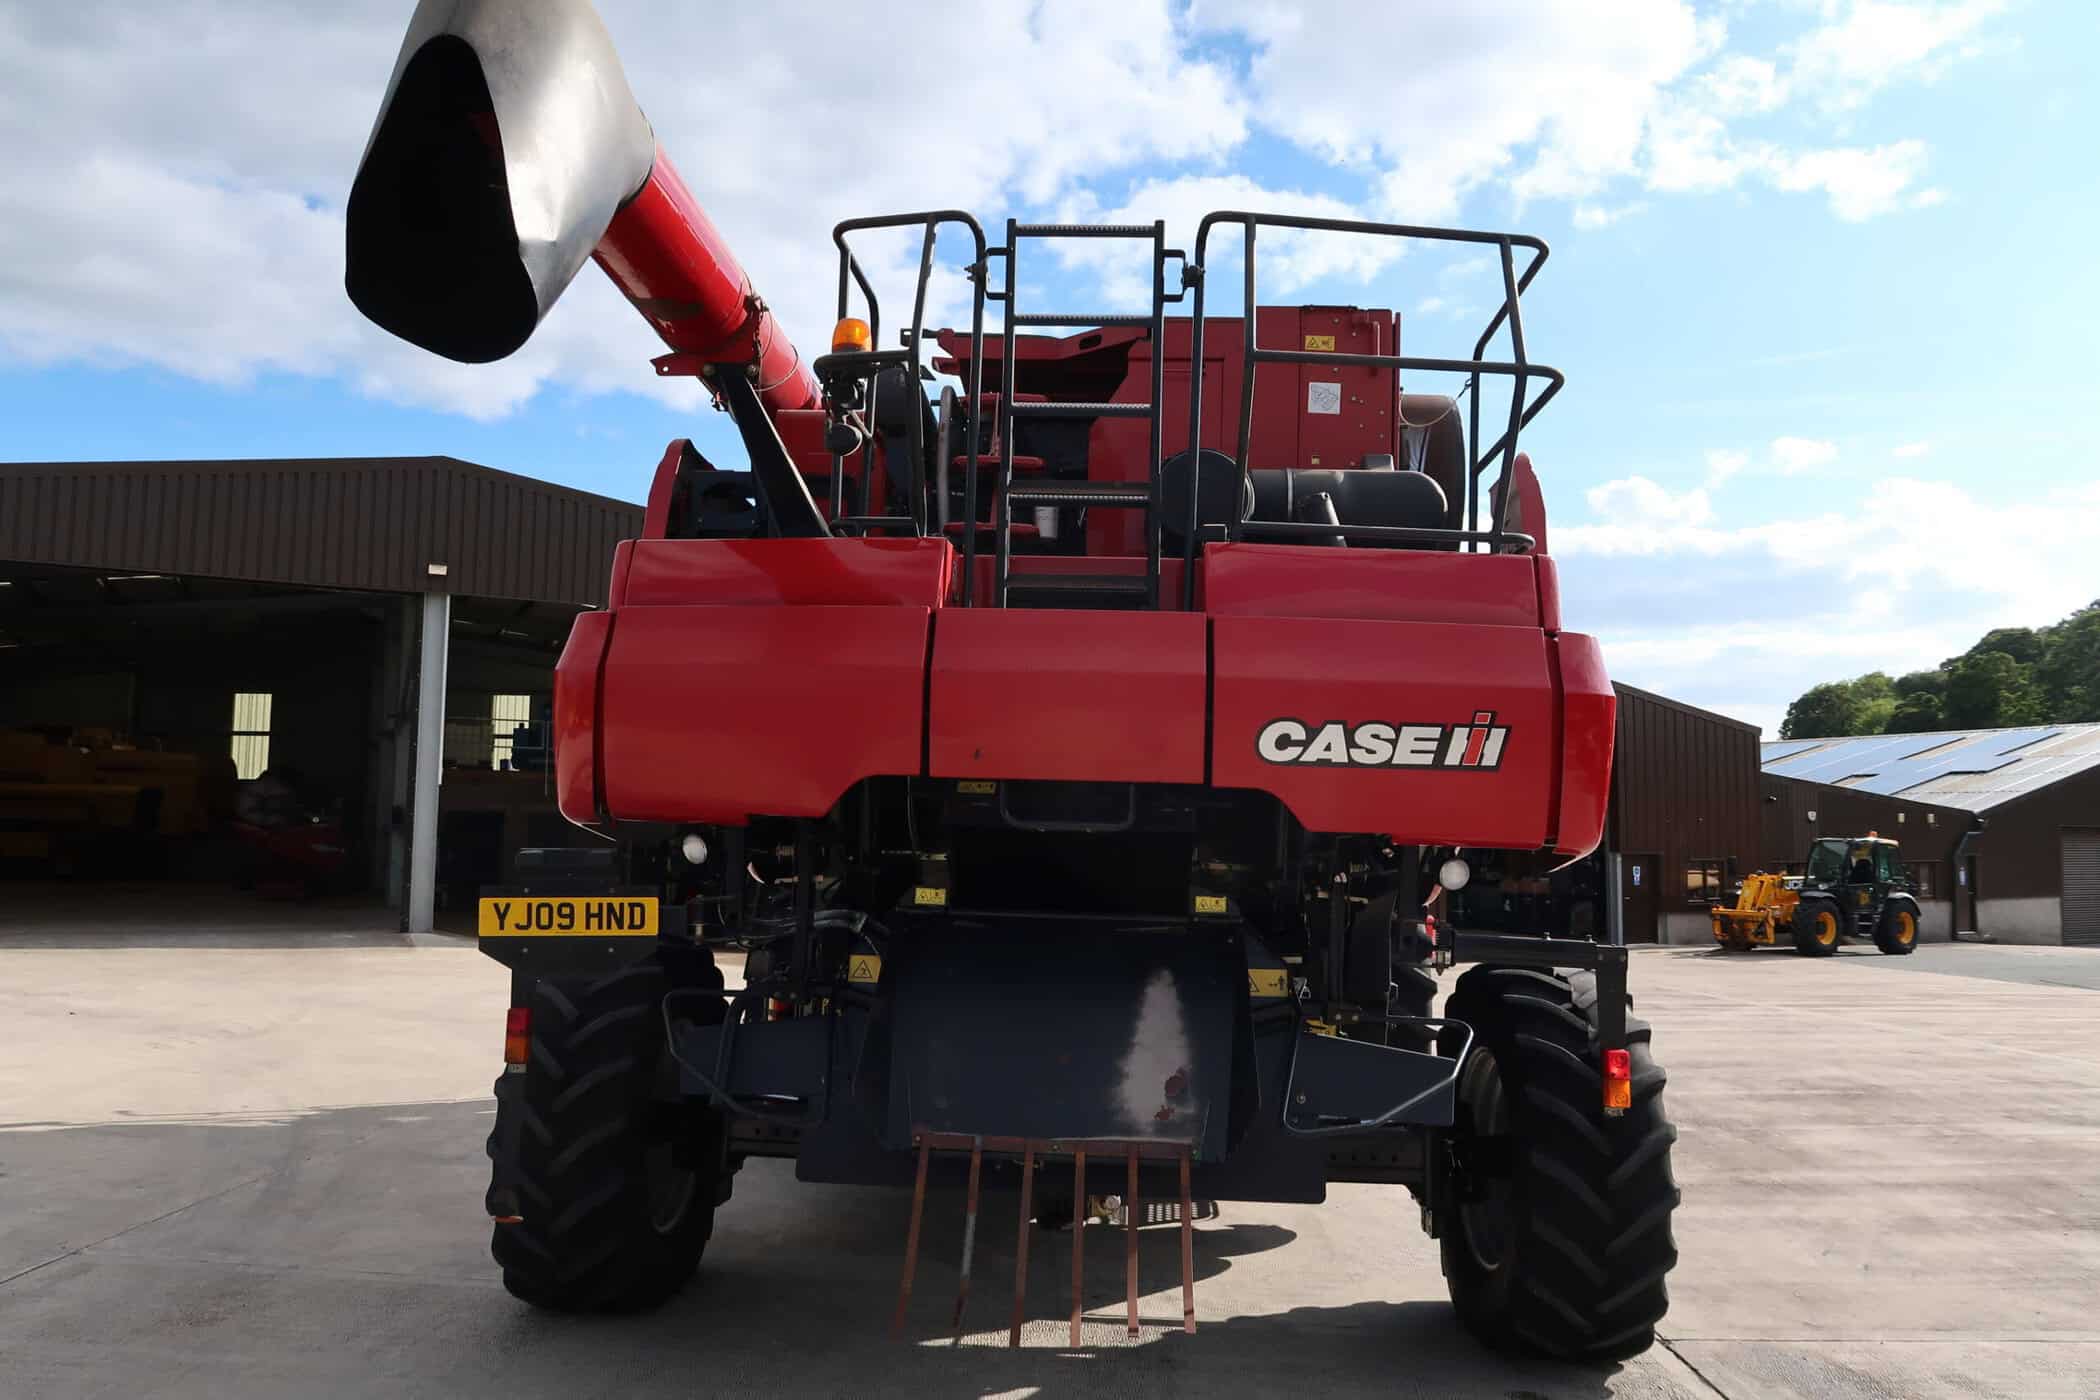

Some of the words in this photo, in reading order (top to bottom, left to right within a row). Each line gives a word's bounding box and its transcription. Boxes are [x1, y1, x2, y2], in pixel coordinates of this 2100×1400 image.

[1258, 721, 1442, 765] CASE
[493, 902, 575, 931] YJ09
[585, 902, 646, 931] HND
